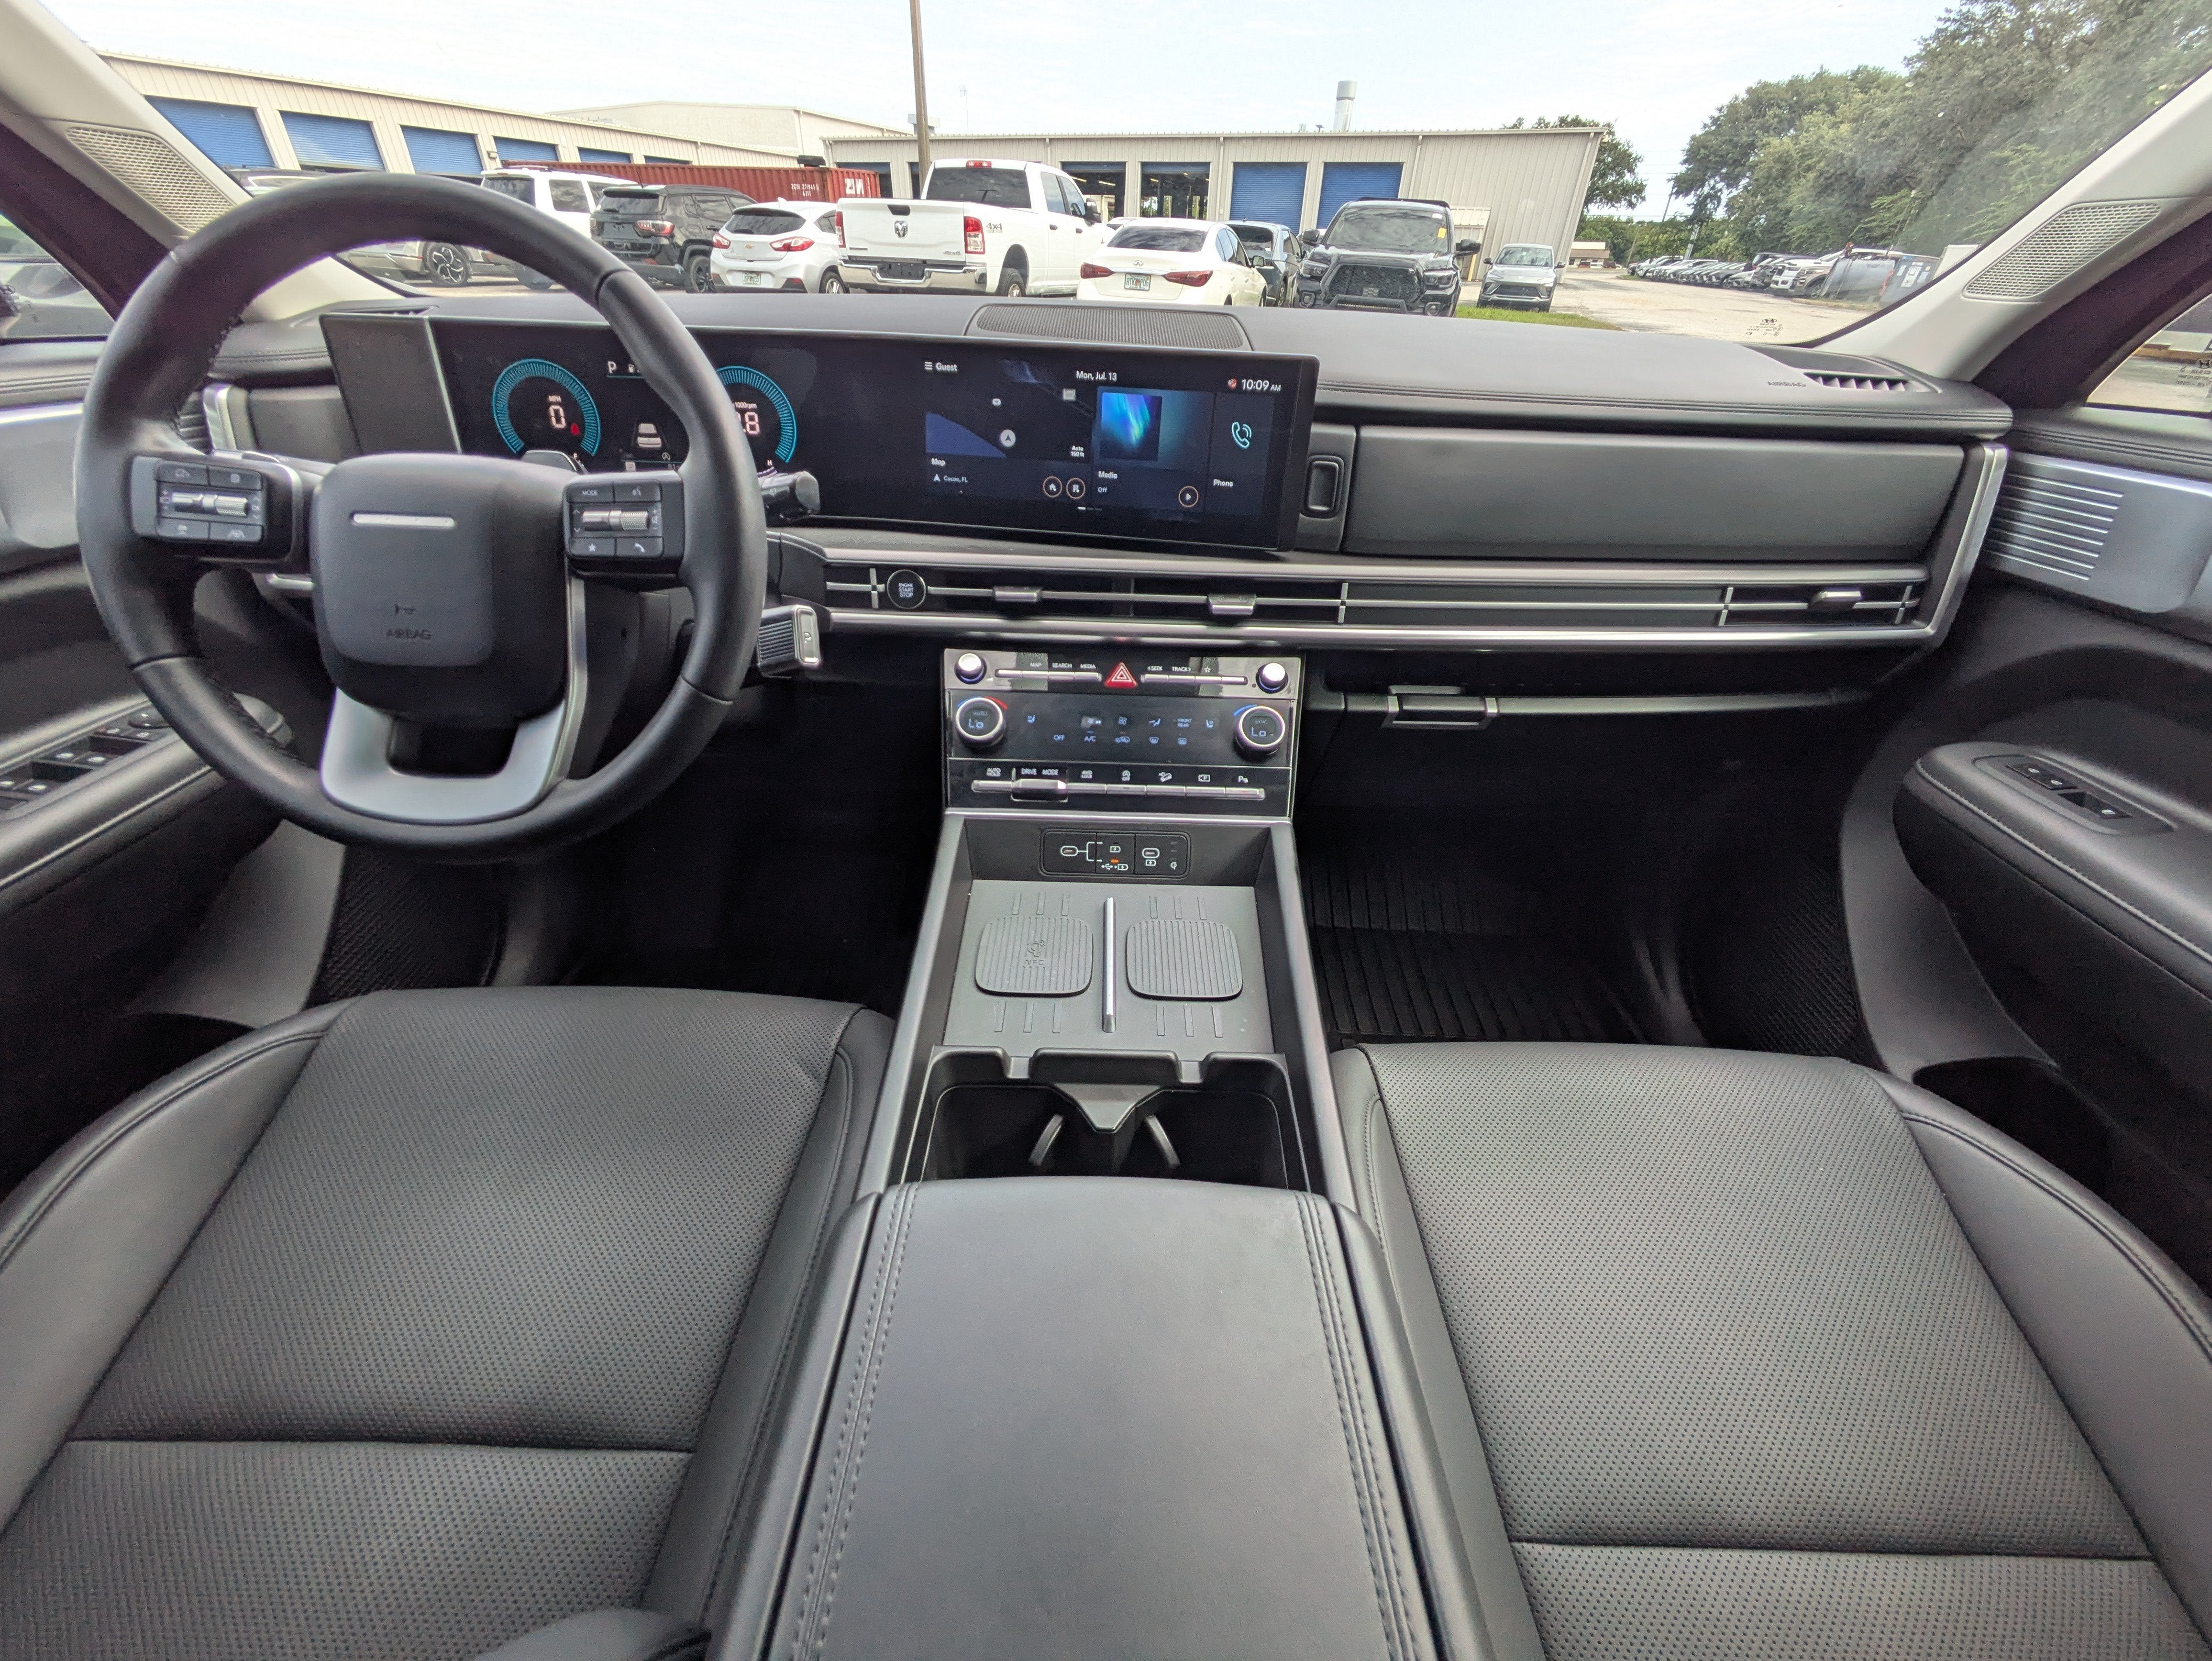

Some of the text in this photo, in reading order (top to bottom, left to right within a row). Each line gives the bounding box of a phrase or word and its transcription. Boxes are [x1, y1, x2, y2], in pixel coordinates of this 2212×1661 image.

[608, 361, 617, 374] P
[936, 362, 957, 371] Guest
[1076, 370, 1117, 381] Mon, Jul. 13
[1242, 379, 1270, 391] 10:09
[549, 405, 566, 429] 0
[1098, 471, 1118, 479] Media
[1214, 479, 1234, 487] Phone
